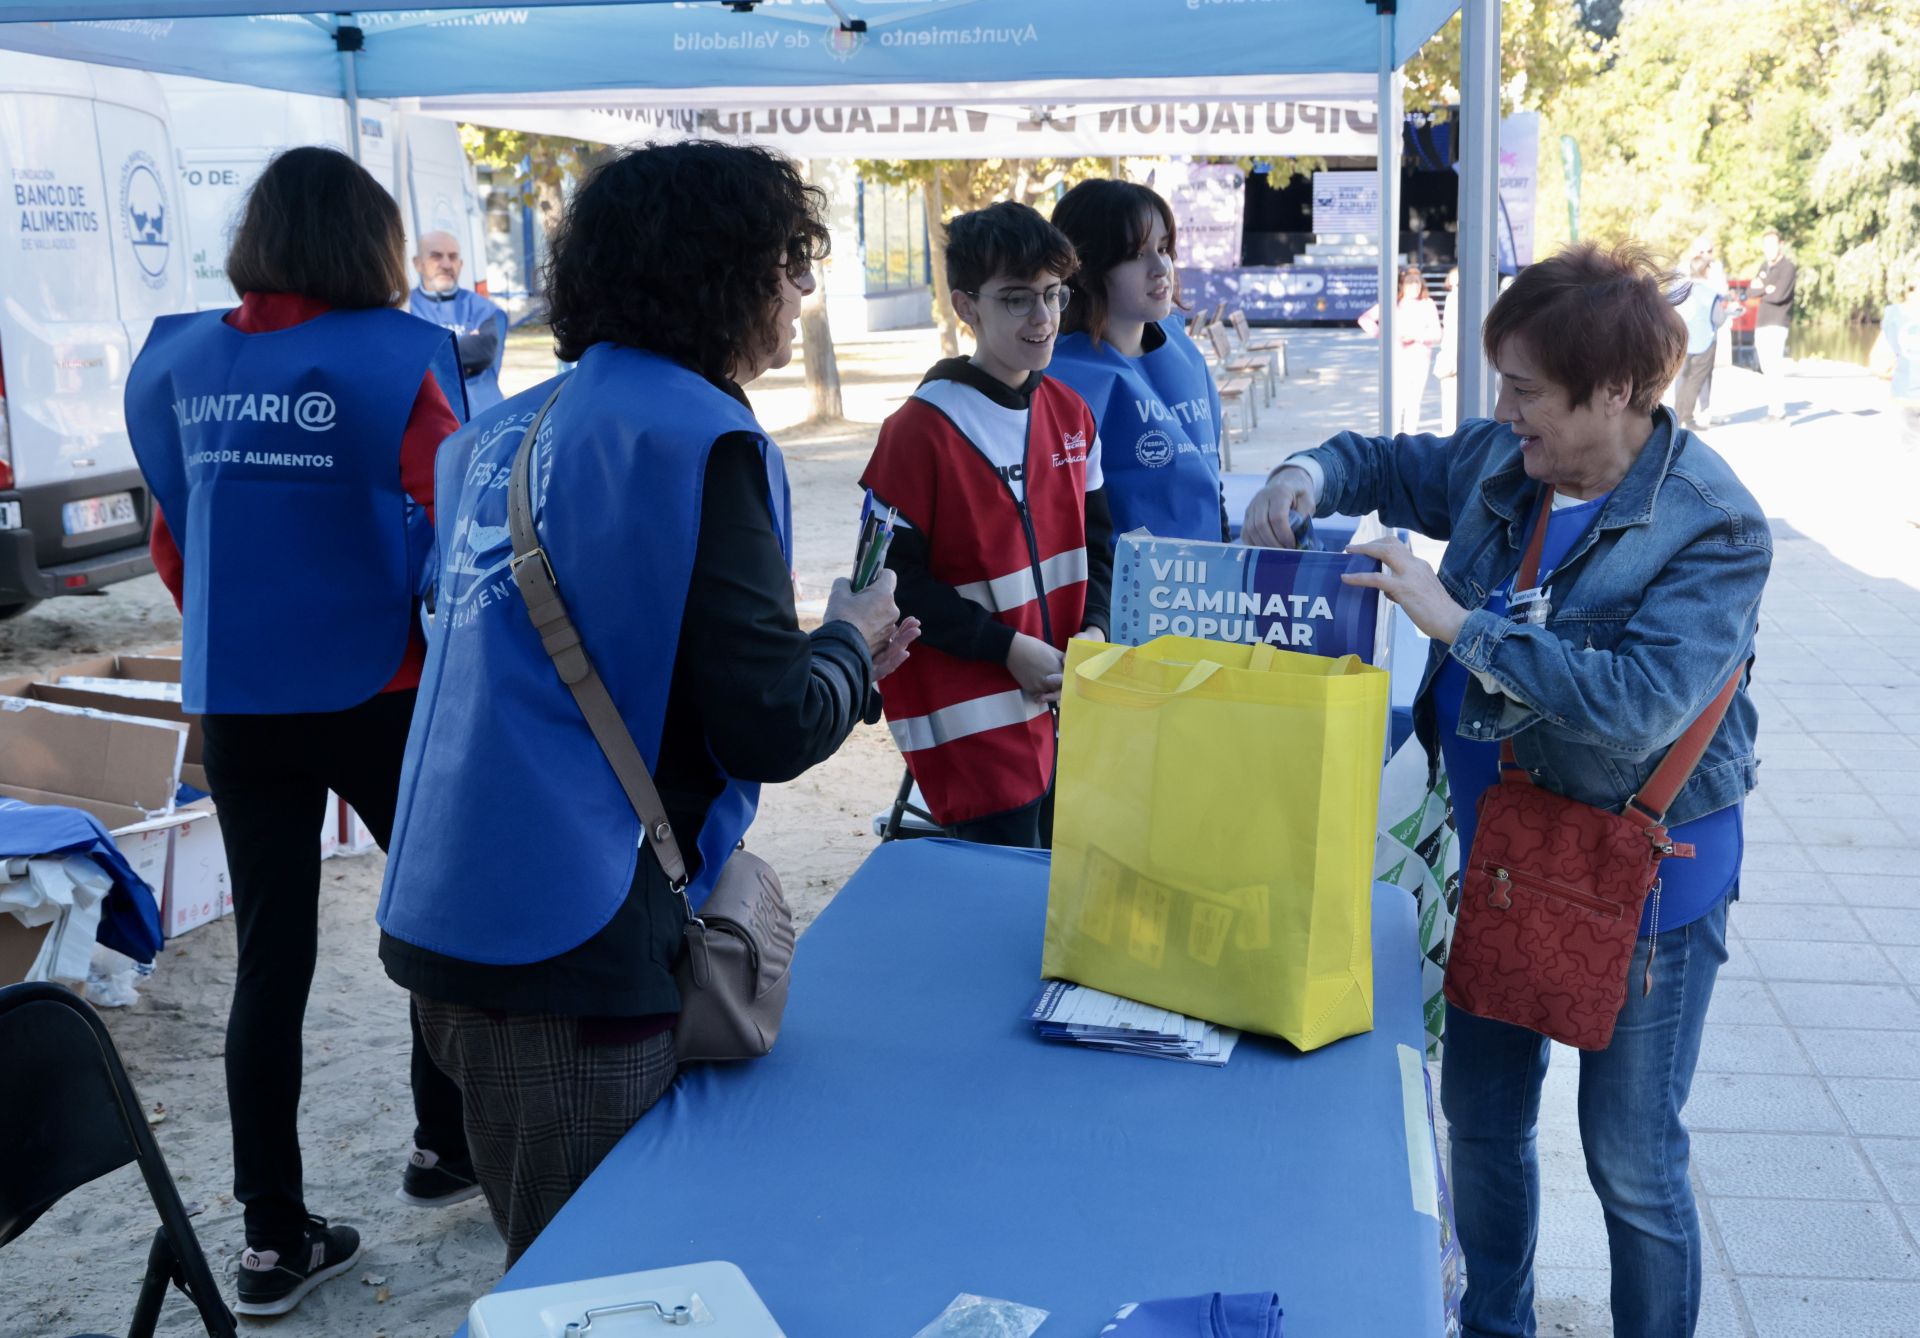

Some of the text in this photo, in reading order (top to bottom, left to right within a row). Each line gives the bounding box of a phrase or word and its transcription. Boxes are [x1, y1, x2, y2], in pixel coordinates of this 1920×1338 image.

[208, 170, 241, 186] DE:
[15, 184, 86, 207] BANCO DE
[21, 211, 99, 232] ALIMENTOS
[221, 450, 241, 463] DE
[244, 451, 334, 468] ALIMENTOS
[1149, 558, 1207, 584] VIII
[1149, 586, 1334, 620] CAMINATA
[1148, 613, 1313, 646] POPULAR
